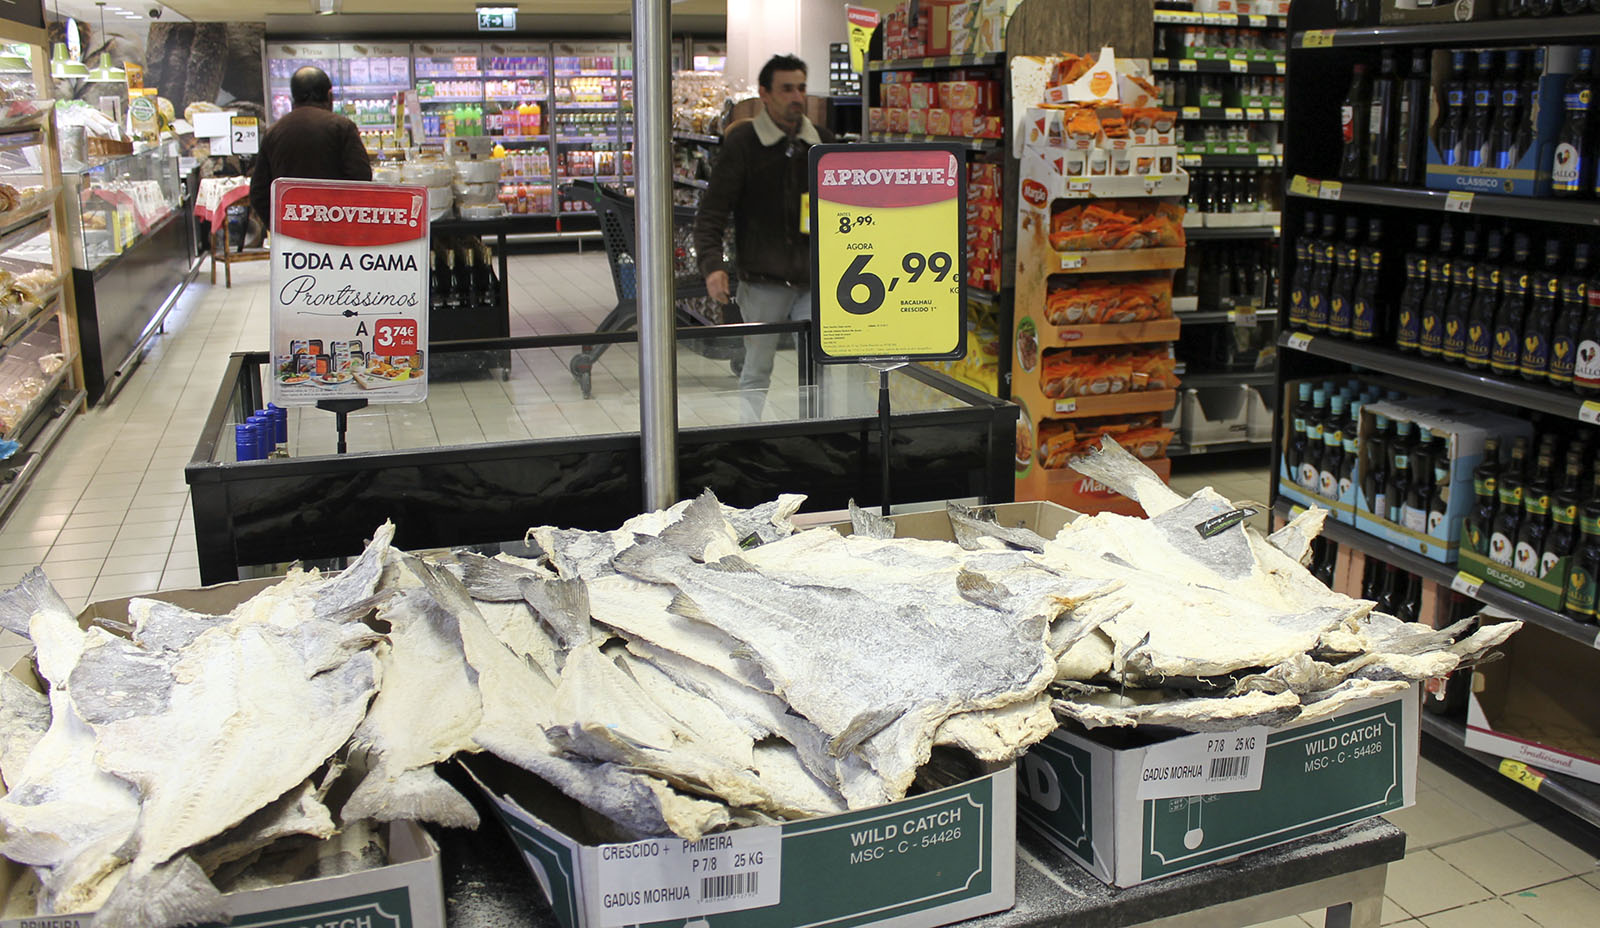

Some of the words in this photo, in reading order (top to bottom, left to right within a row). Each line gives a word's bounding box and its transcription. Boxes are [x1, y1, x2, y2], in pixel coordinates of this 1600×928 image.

[822, 154, 959, 187] APROVEITE!
[282, 195, 423, 228] APROVEITE!
[846, 243, 873, 251] AGORA
[282, 252, 334, 270] TODA
[340, 253, 353, 270] A
[360, 253, 418, 271] GAMA
[356, 321, 369, 337] A
[1487, 568, 1526, 589] DELICADO
[1207, 740, 1213, 752] P
[1213, 738, 1226, 752] 7/8
[1235, 737, 1245, 751] 25
[1245, 737, 1256, 750] KG
[1305, 736, 1338, 756] WILD
[1341, 723, 1382, 746] CATCH
[1305, 756, 1329, 773] MSC
[1337, 751, 1346, 764] C
[1353, 741, 1382, 759] 54426
[1143, 767, 1169, 782] GADUS
[1170, 765, 1204, 780] MORHUA
[850, 824, 898, 847] WILD
[902, 807, 961, 835] CATCH
[602, 842, 660, 861] CRESCIDO
[682, 835, 733, 854] PRIMEIRA
[850, 846, 885, 865] MSC
[897, 841, 909, 853] C
[921, 827, 961, 848] 54426
[692, 859, 700, 872] P
[703, 857, 717, 872] 7/8
[734, 854, 746, 868] 25
[748, 851, 763, 865] KG
[603, 892, 641, 908] GADUS
[643, 886, 690, 904] MORHUA
